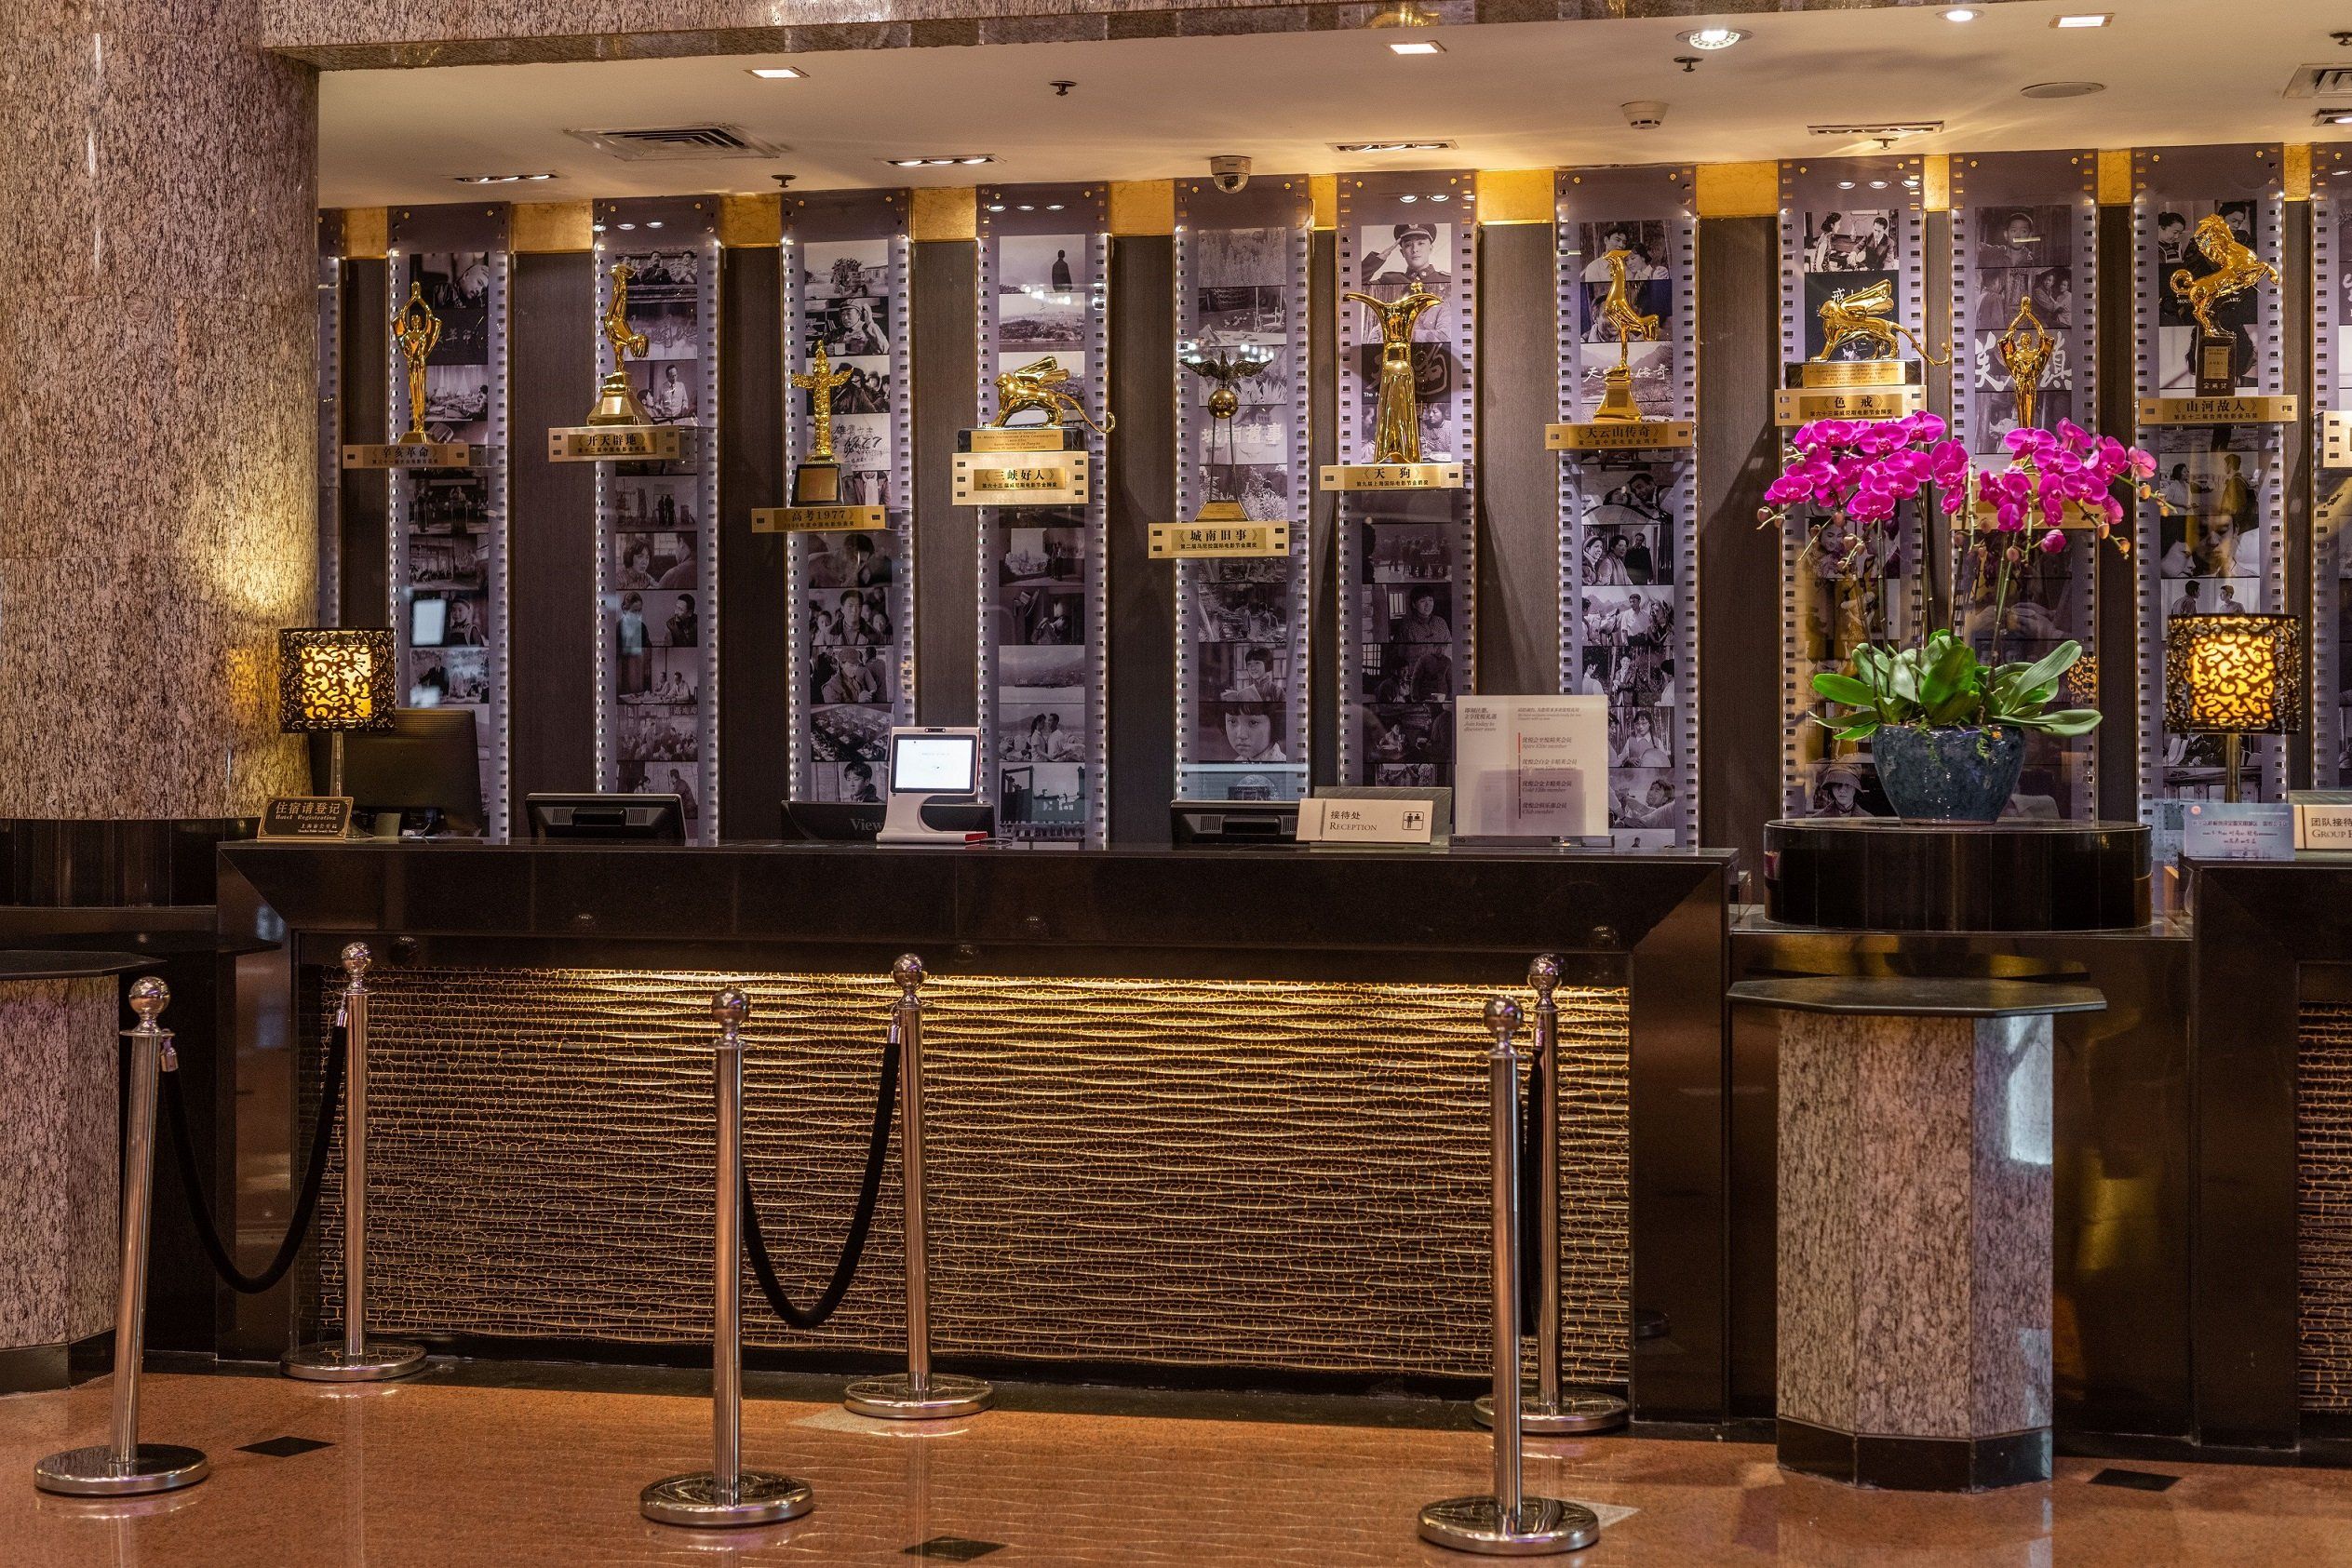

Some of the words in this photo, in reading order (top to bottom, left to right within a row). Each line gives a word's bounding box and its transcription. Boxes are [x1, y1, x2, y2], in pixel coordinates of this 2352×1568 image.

[276, 801, 341, 814] 住宿请登记
[1330, 811, 1361, 820] 接待处
